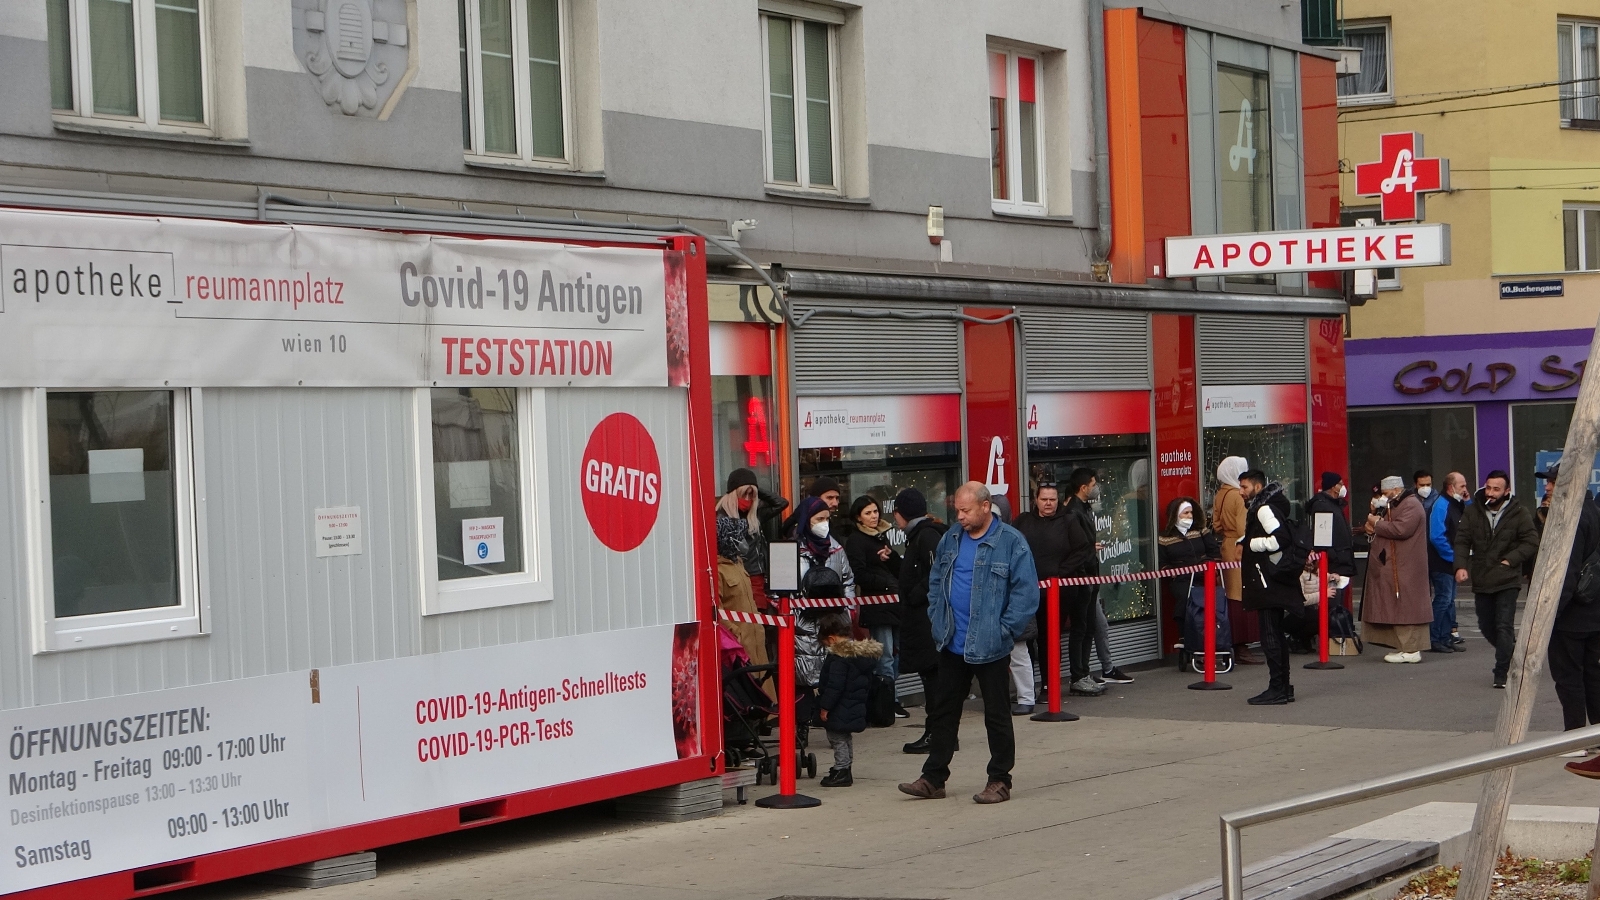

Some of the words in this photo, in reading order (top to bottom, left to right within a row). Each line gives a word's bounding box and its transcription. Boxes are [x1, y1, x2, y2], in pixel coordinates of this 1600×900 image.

[1193, 234, 1415, 270] APOTHEKE
[399, 261, 529, 311] Covid-19
[537, 269, 643, 324] Antigen
[282, 333, 322, 353] wien
[329, 334, 348, 353] 10
[441, 337, 613, 376] TESTSTATION
[1393, 360, 1517, 395] GOLD
[1160, 448, 1191, 465] apotheke
[585, 459, 658, 505] GRATIS
[1099, 537, 1132, 564] Christmas
[415, 670, 647, 725] COVID-19-Antigen-Schnelltests
[9, 706, 211, 761] ÖFFNUNGSZEITEN:
[417, 717, 574, 763] COVID-19-PCR-Tests
[9, 766, 77, 796] Montag
[94, 757, 152, 782] Freitag
[163, 745, 202, 770] 09:00
[217, 737, 255, 762] 17:00
[259, 733, 286, 755] Uhr
[10, 790, 140, 826] Desinfektionspause
[145, 782, 175, 802] 13:00
[189, 775, 218, 795] 13:30
[221, 772, 242, 788] Uhr
[14, 839, 92, 869] Samstag
[167, 812, 208, 839] 09:00
[221, 803, 260, 828] 13:00
[263, 798, 290, 820] Uhr
